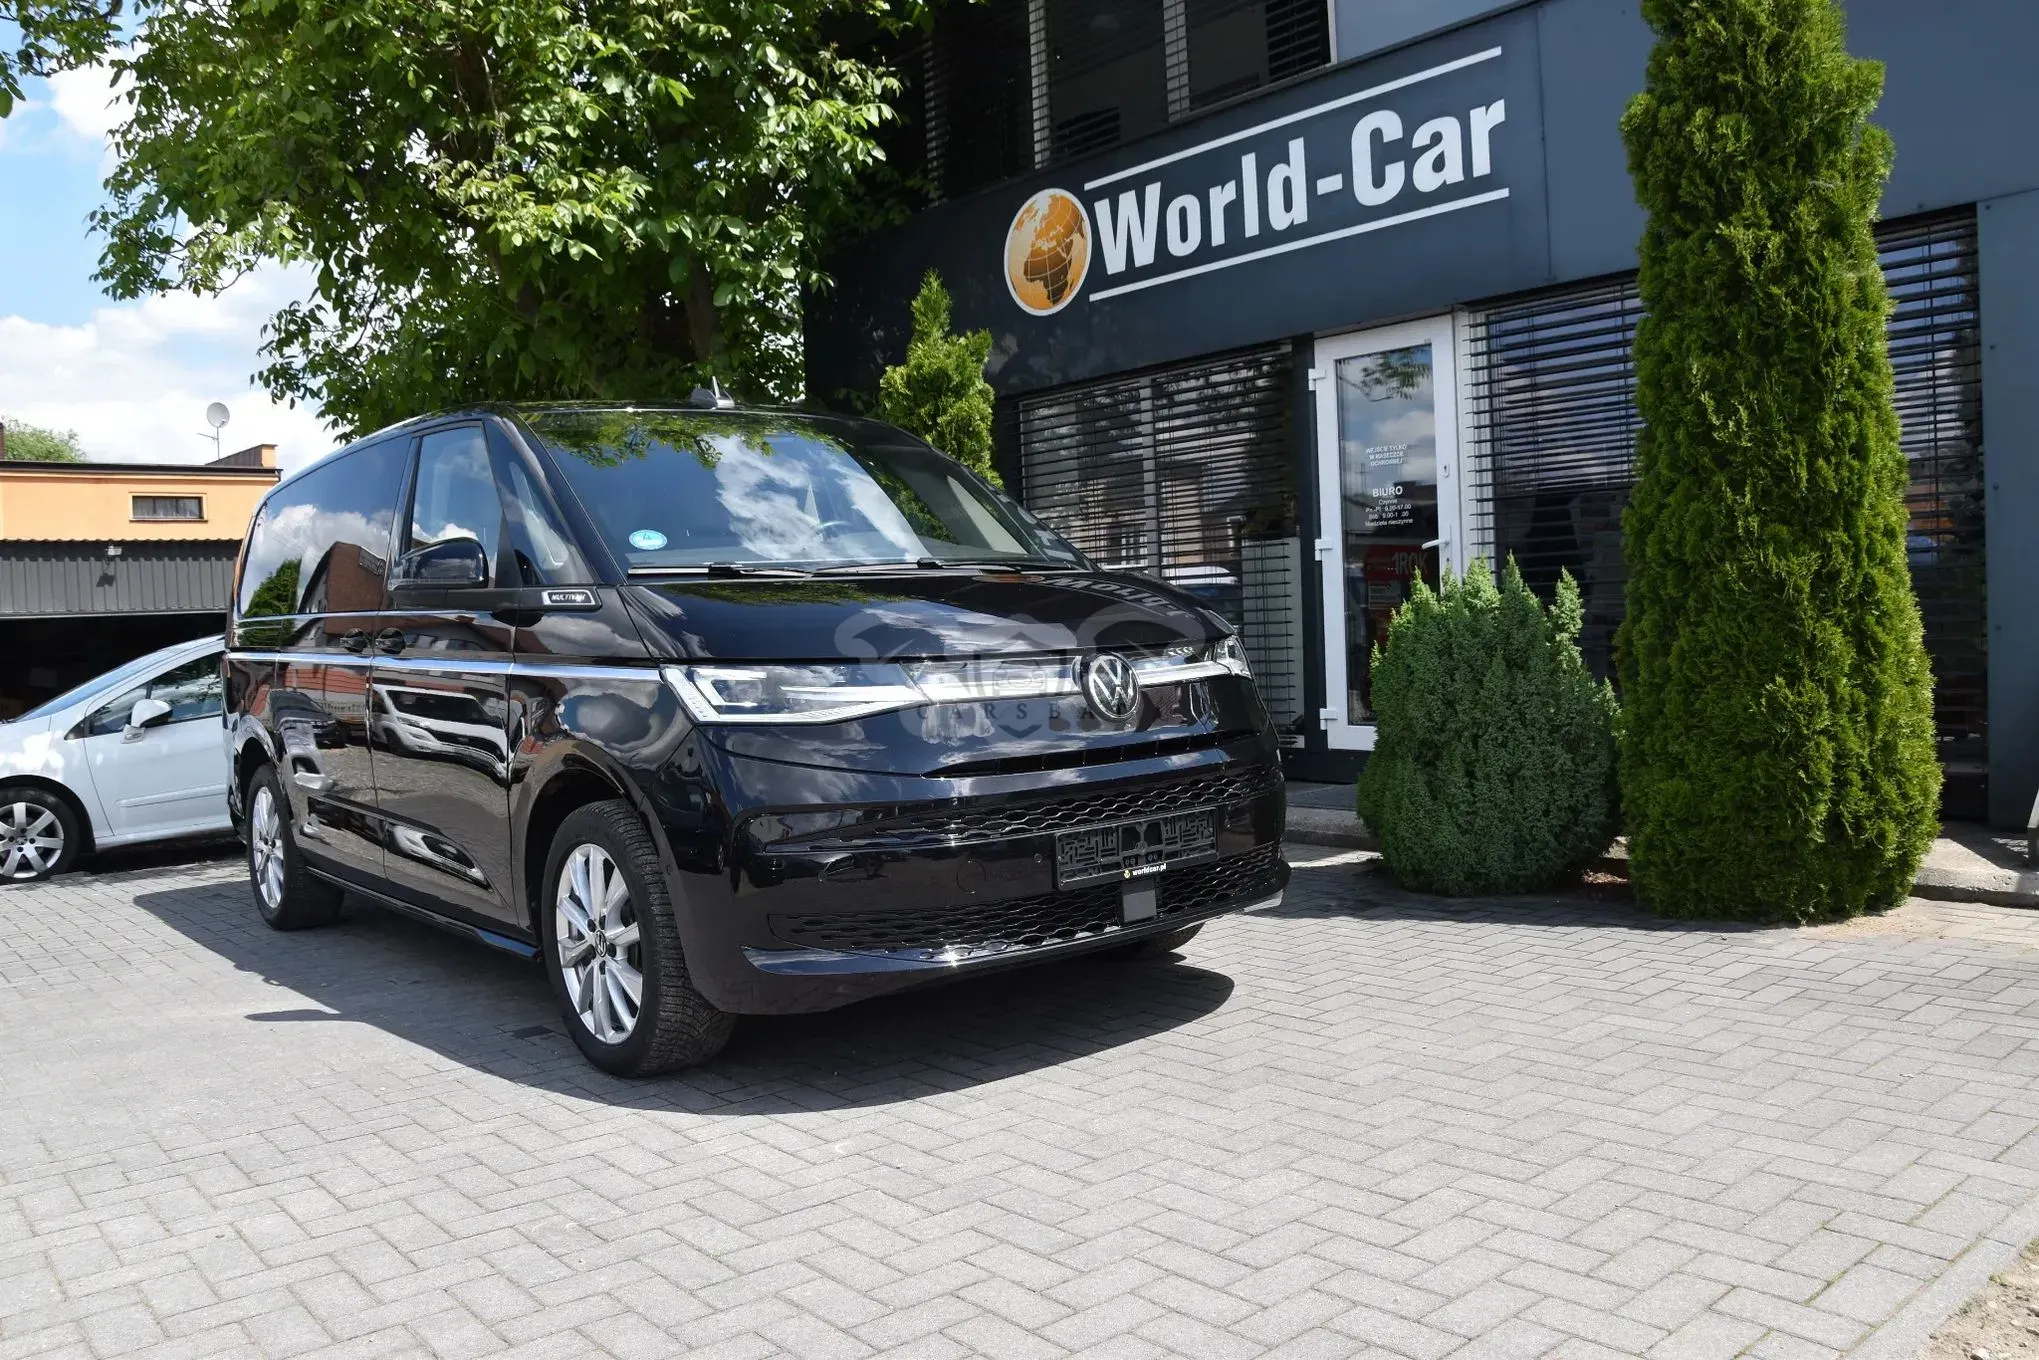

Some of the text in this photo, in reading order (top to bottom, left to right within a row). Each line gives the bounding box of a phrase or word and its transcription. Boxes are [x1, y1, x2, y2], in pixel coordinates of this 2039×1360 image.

[1092, 98, 1507, 275] World-Car
[1372, 486, 1403, 497] BIURO
[1132, 863, 1167, 876] worldcar.pl
